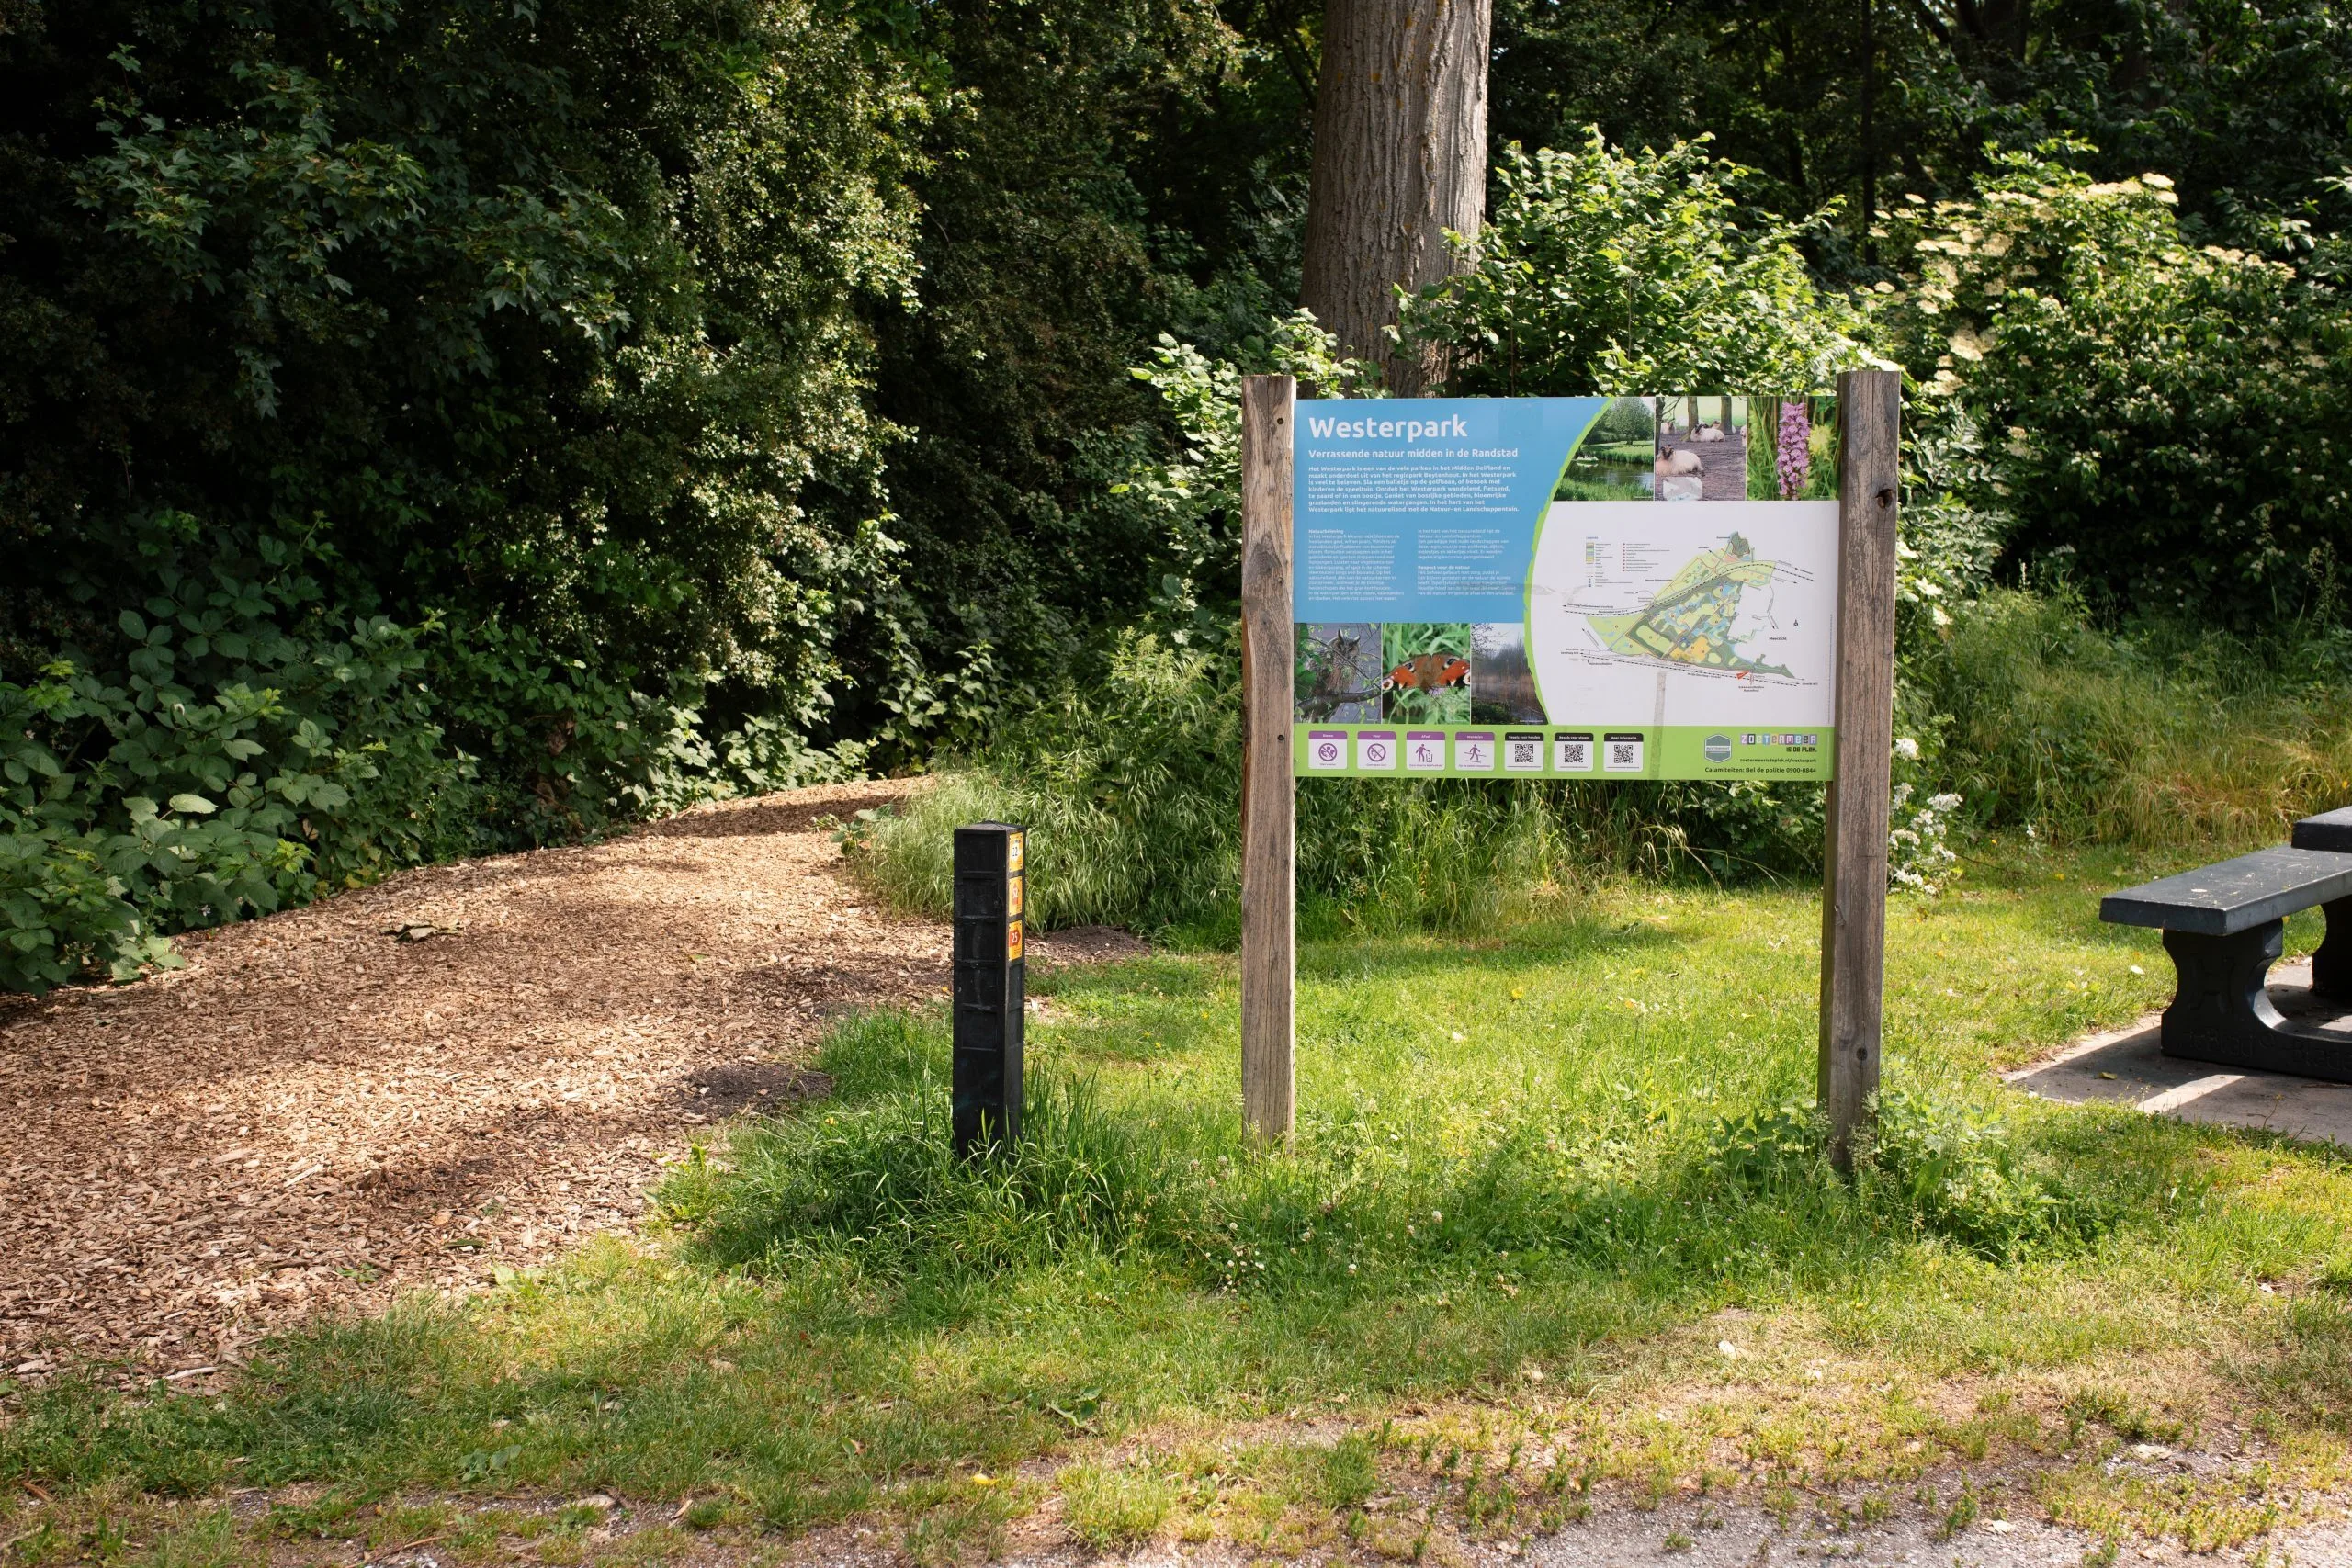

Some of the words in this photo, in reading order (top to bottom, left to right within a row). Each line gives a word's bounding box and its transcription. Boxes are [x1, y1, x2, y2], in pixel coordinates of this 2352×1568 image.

[1308, 414, 1468, 443] Westerpark
[1308, 449, 1370, 457] Verrassende
[1372, 449, 1404, 457] natuur
[1408, 449, 1443, 457] midden
[1445, 449, 1454, 457] in
[1457, 449, 1469, 457] de
[1472, 449, 1518, 457] Randstad
[1012, 931, 1019, 943] 25
